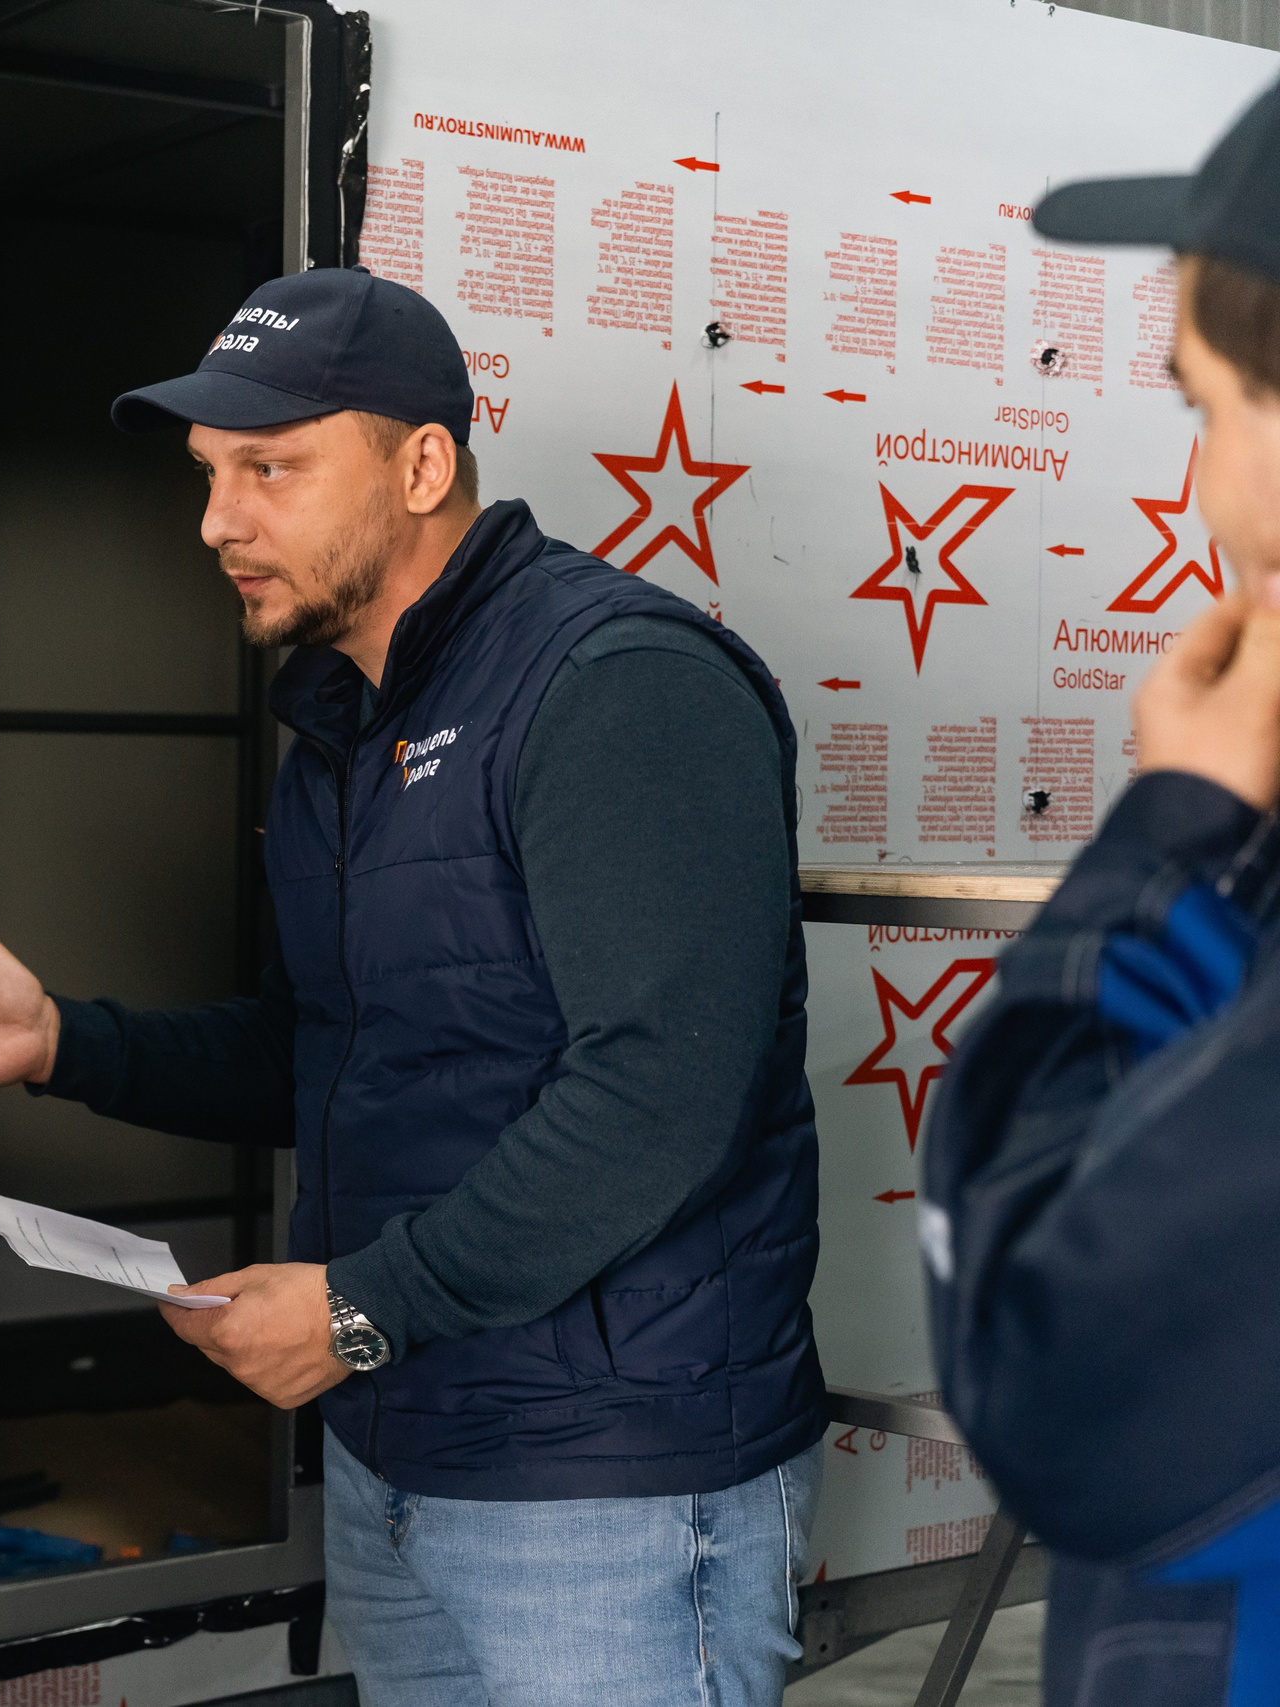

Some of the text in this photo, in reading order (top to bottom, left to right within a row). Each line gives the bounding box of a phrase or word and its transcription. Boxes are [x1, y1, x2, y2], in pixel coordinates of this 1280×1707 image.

[414, 113, 586, 153] WWW.ALUMINSTROY.RU
[994, 406, 1069, 433] GoldStar
[876, 428, 1069, 482] Алюминстрой
[1053, 619, 1183, 655] Алюминс
[1053, 667, 1126, 690] GoldStar
